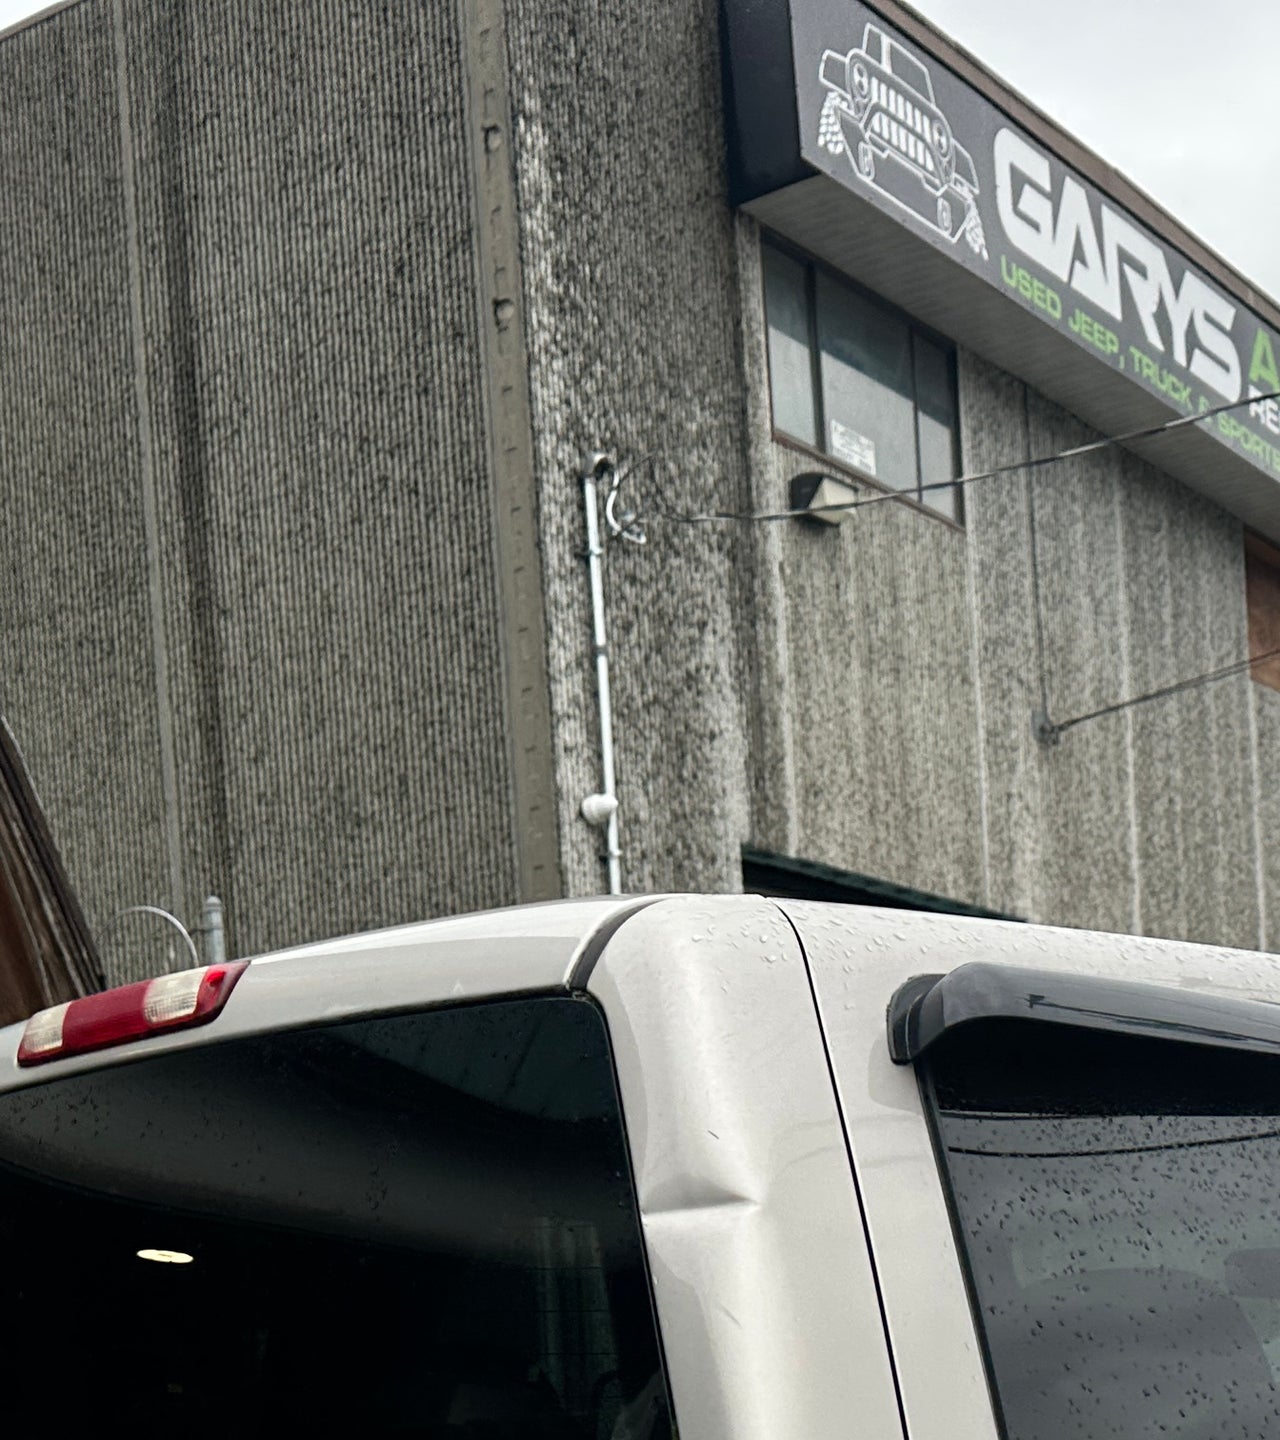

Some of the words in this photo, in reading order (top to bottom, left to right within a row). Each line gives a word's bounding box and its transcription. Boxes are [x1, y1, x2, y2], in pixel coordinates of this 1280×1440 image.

[994, 127, 1242, 403] GARYS
[1001, 254, 1062, 320] USED
[1129, 345, 1192, 411] TRUCK
